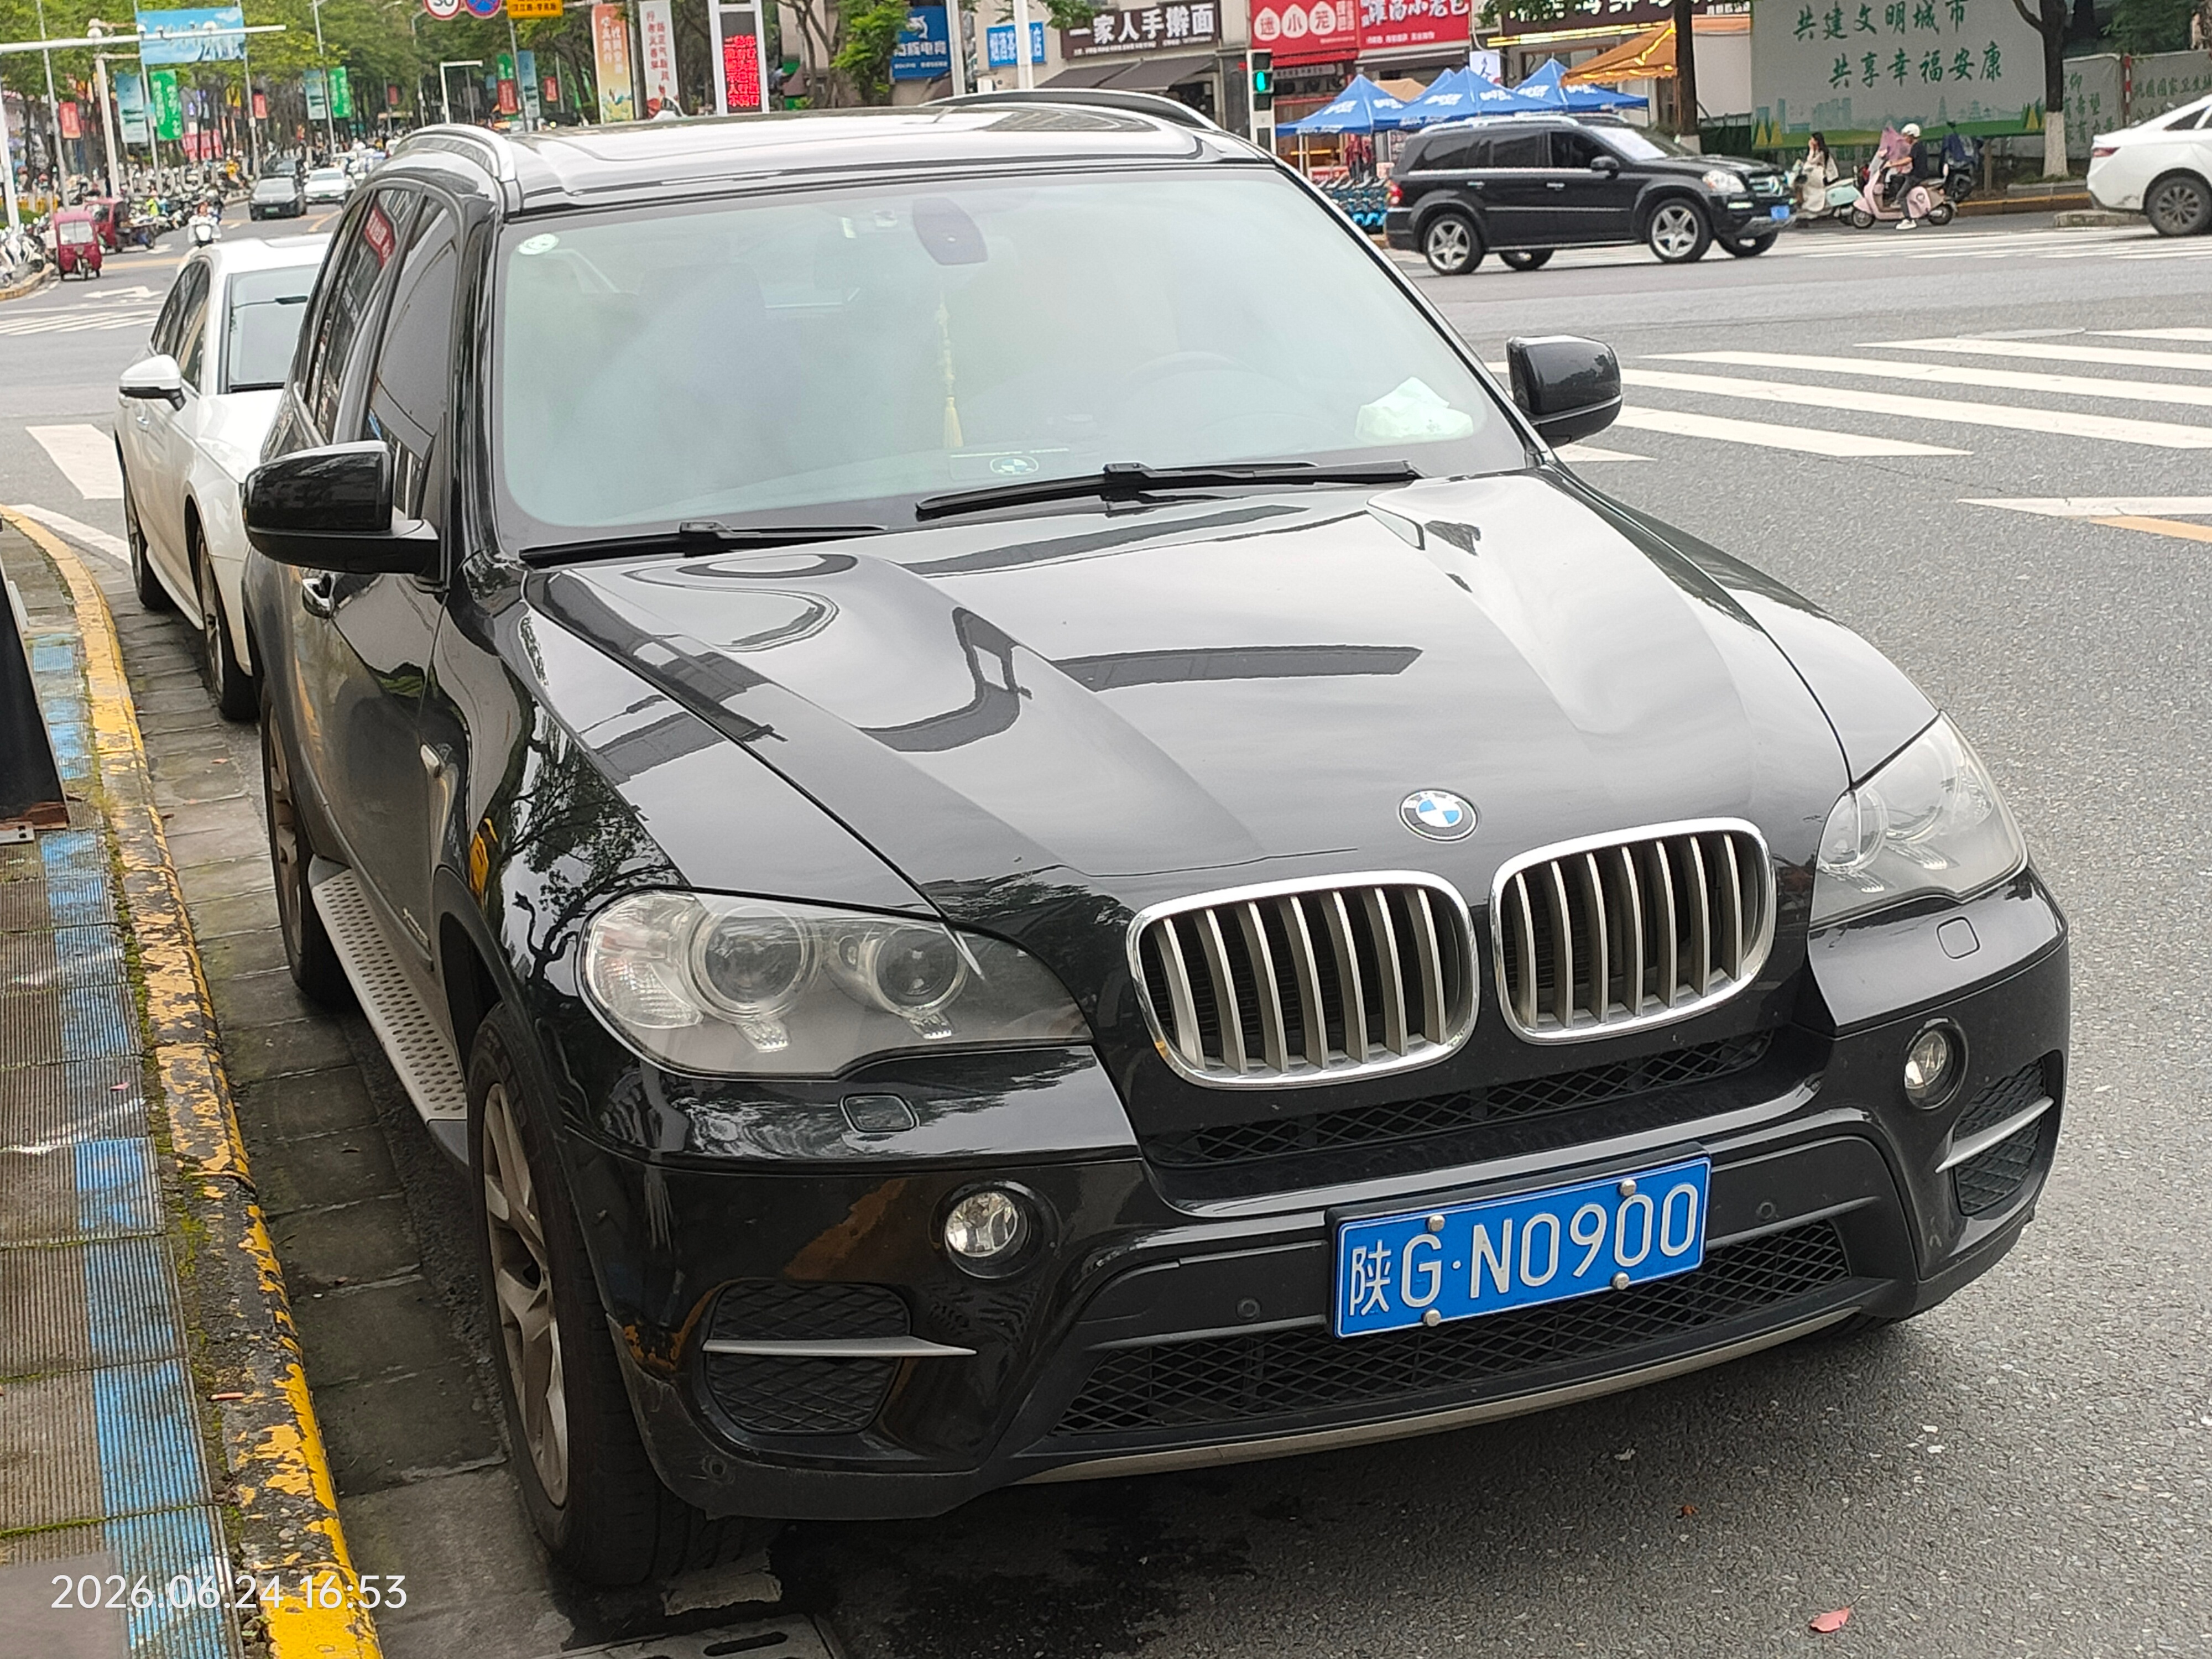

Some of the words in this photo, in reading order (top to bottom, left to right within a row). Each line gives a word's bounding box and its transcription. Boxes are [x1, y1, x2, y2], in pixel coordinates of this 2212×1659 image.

[1069, 2, 1215, 45] 一家人手擀面
[1792, 0, 1969, 41] 共建文明城市
[1828, 40, 2002, 90] 共享幸福安康
[1349, 1183, 1699, 1316] 陕G·N0900
